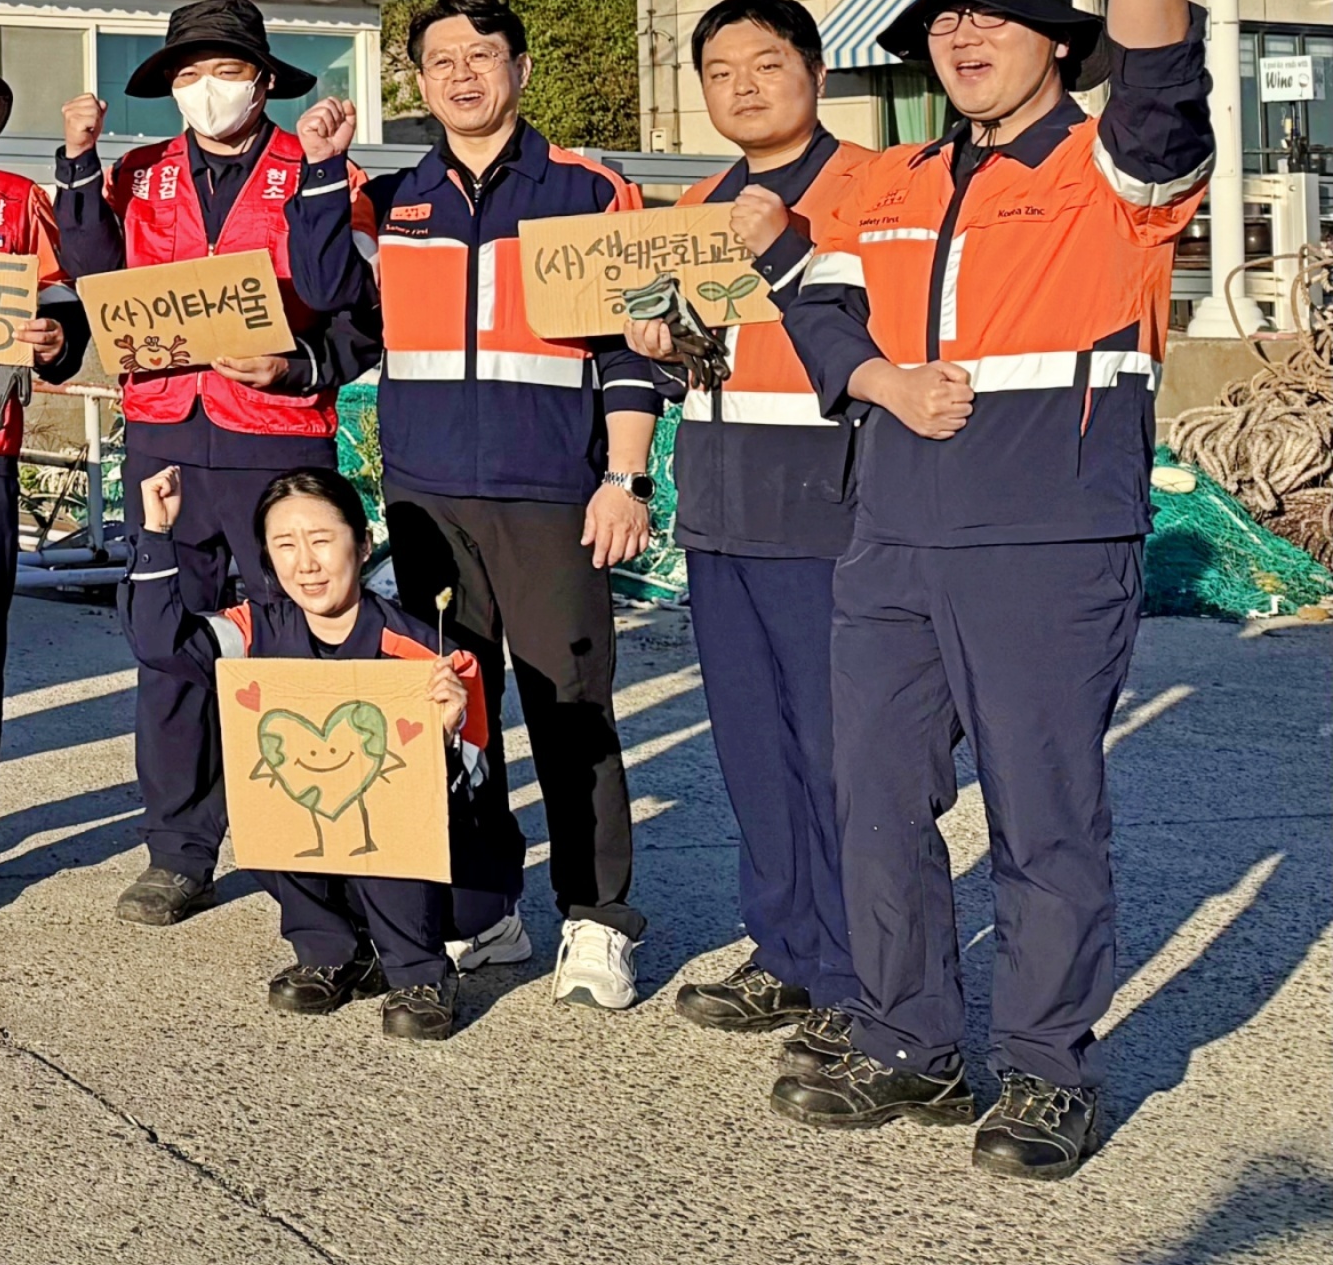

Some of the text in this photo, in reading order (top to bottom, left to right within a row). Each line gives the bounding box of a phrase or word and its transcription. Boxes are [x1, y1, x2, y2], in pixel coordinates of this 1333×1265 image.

[1266, 71, 1293, 89] Wine
[997, 205, 1046, 218] Korea Zinc
[100, 277, 273, 333] (사)이타서울
